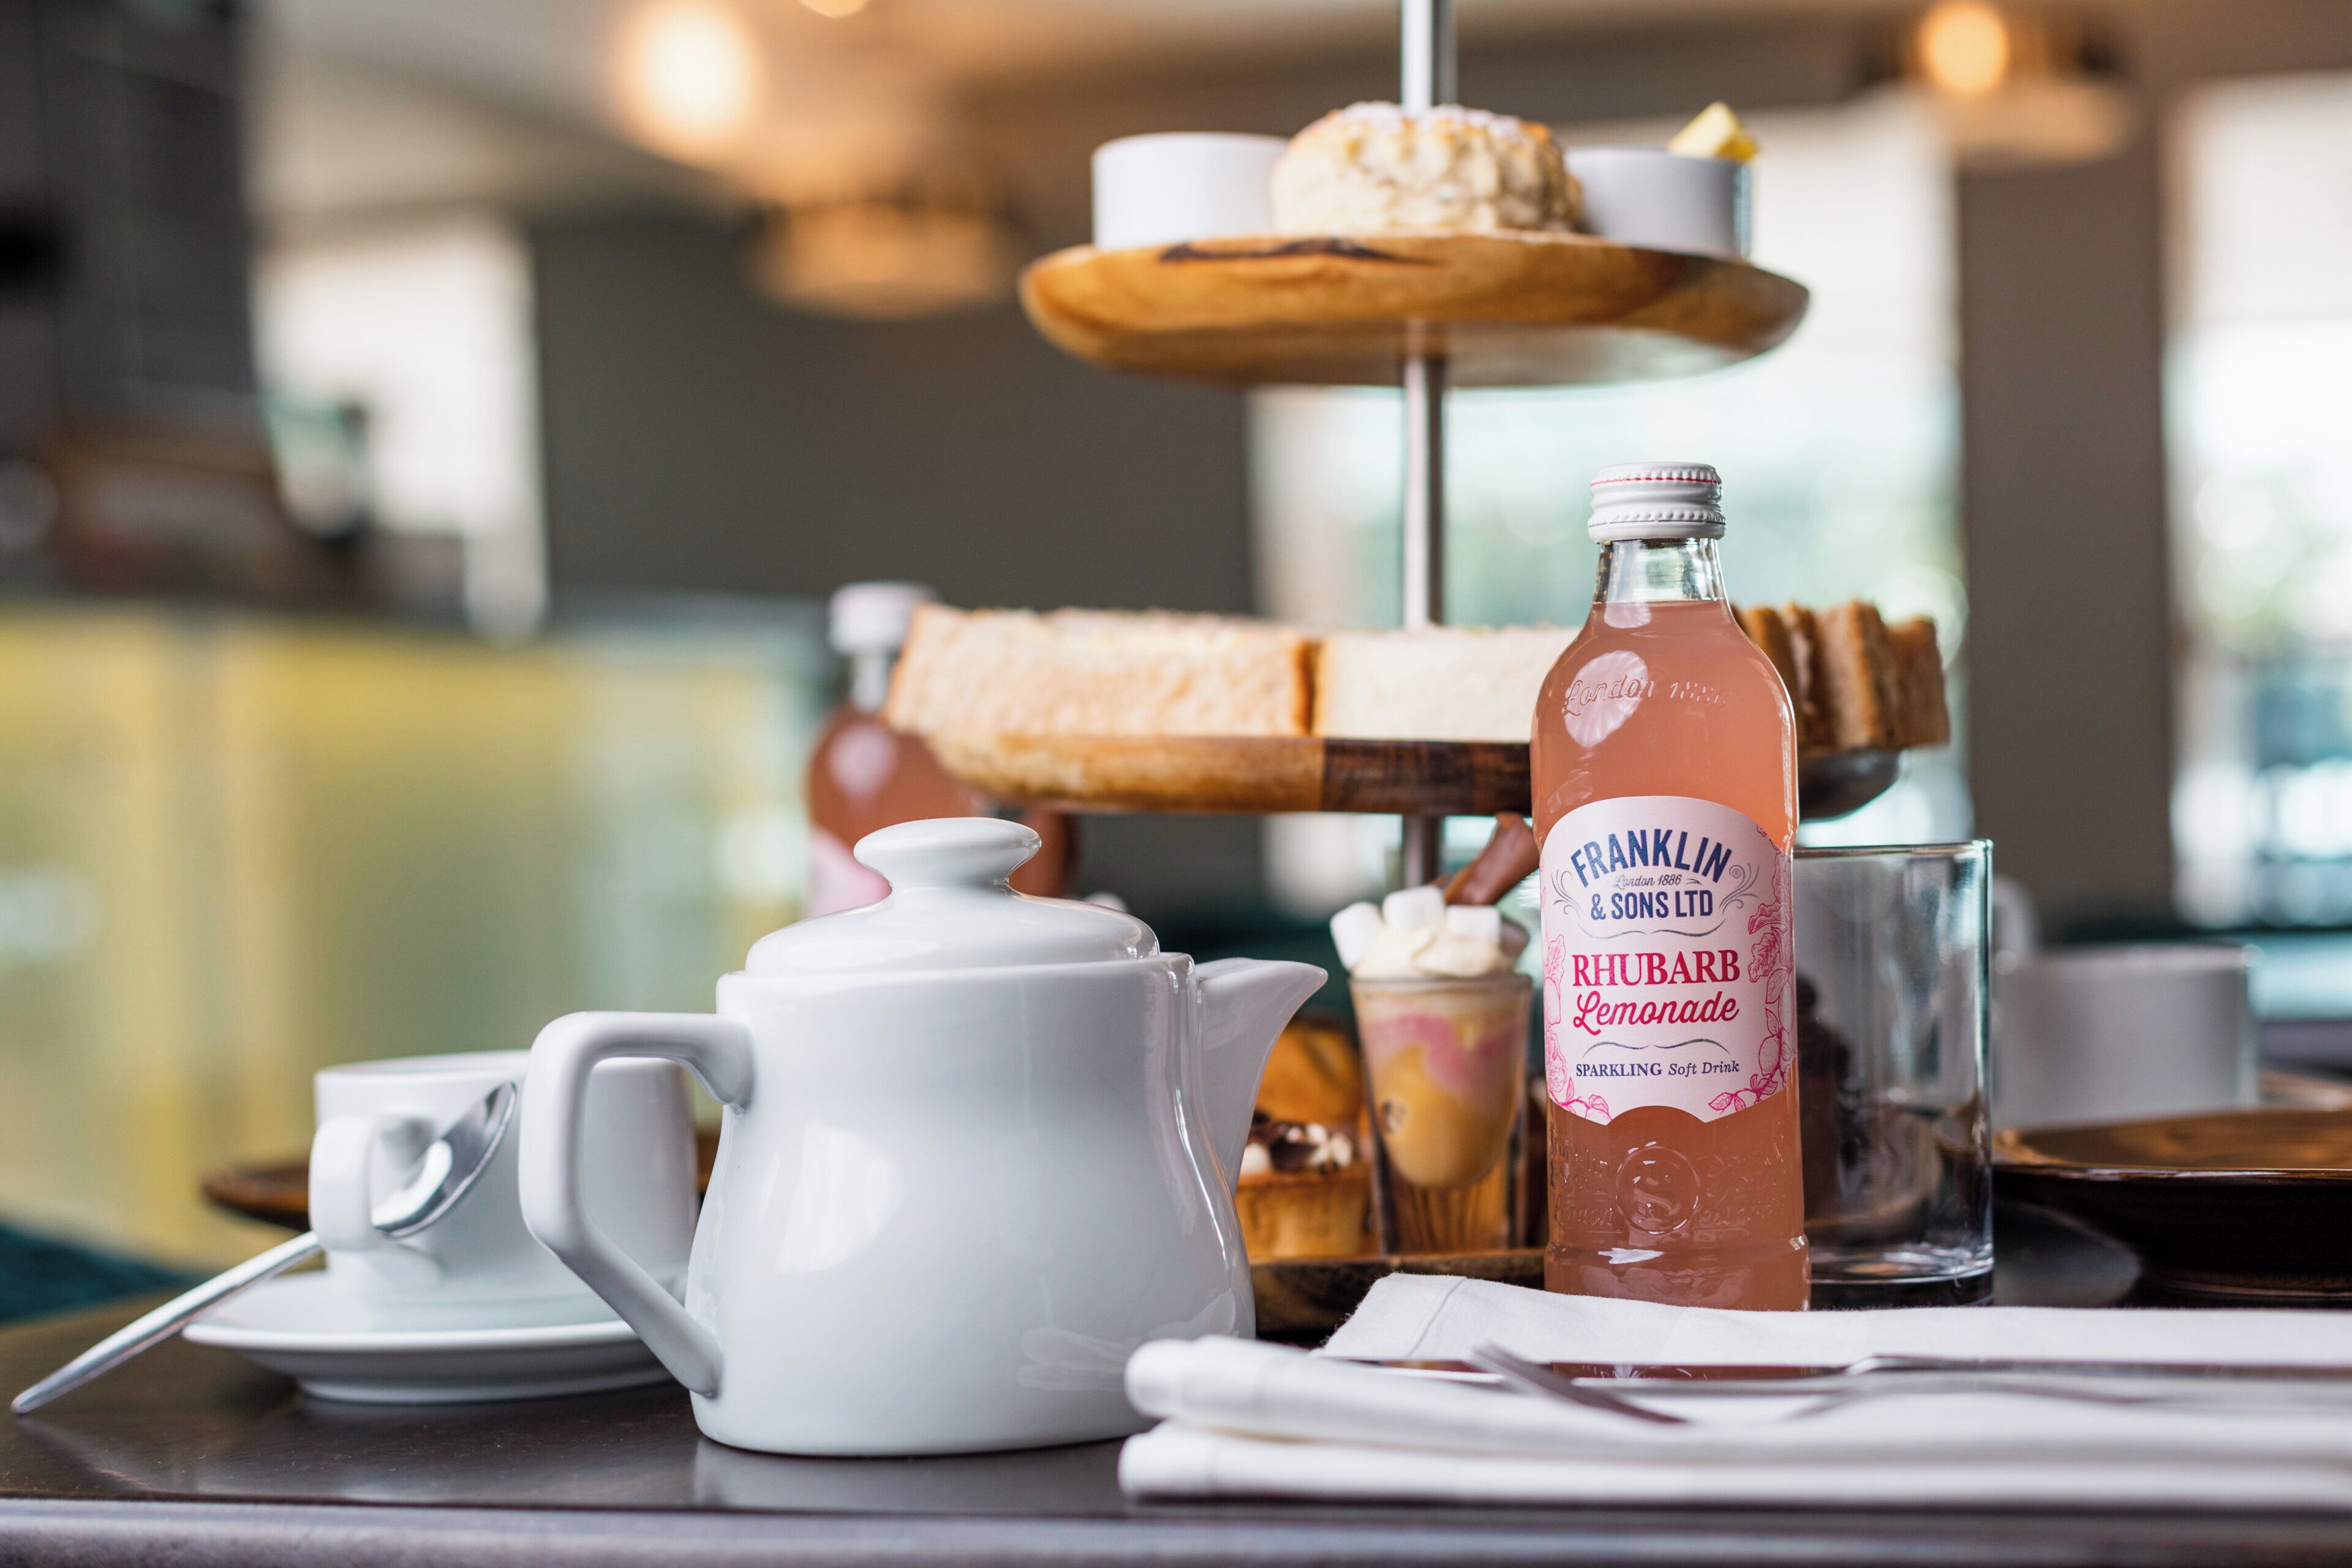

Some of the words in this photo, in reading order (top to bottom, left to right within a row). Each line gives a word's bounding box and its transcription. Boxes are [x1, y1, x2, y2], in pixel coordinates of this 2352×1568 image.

[1561, 674, 1654, 717] London
[1571, 828, 1732, 888] FRANKLIN
[1613, 875, 1655, 890] London
[1657, 874, 1683, 886] 1886
[1591, 893, 1606, 921] &
[1611, 891, 1668, 919] SONS
[1675, 889, 1713, 918] LTD
[1572, 950, 1740, 987] RHUBARB
[1573, 990, 1740, 1036] Lemonade
[1576, 1063, 1662, 1077] SPARKLING
[1668, 1063, 1697, 1077] Soft
[1702, 1060, 1740, 1075] Drink
